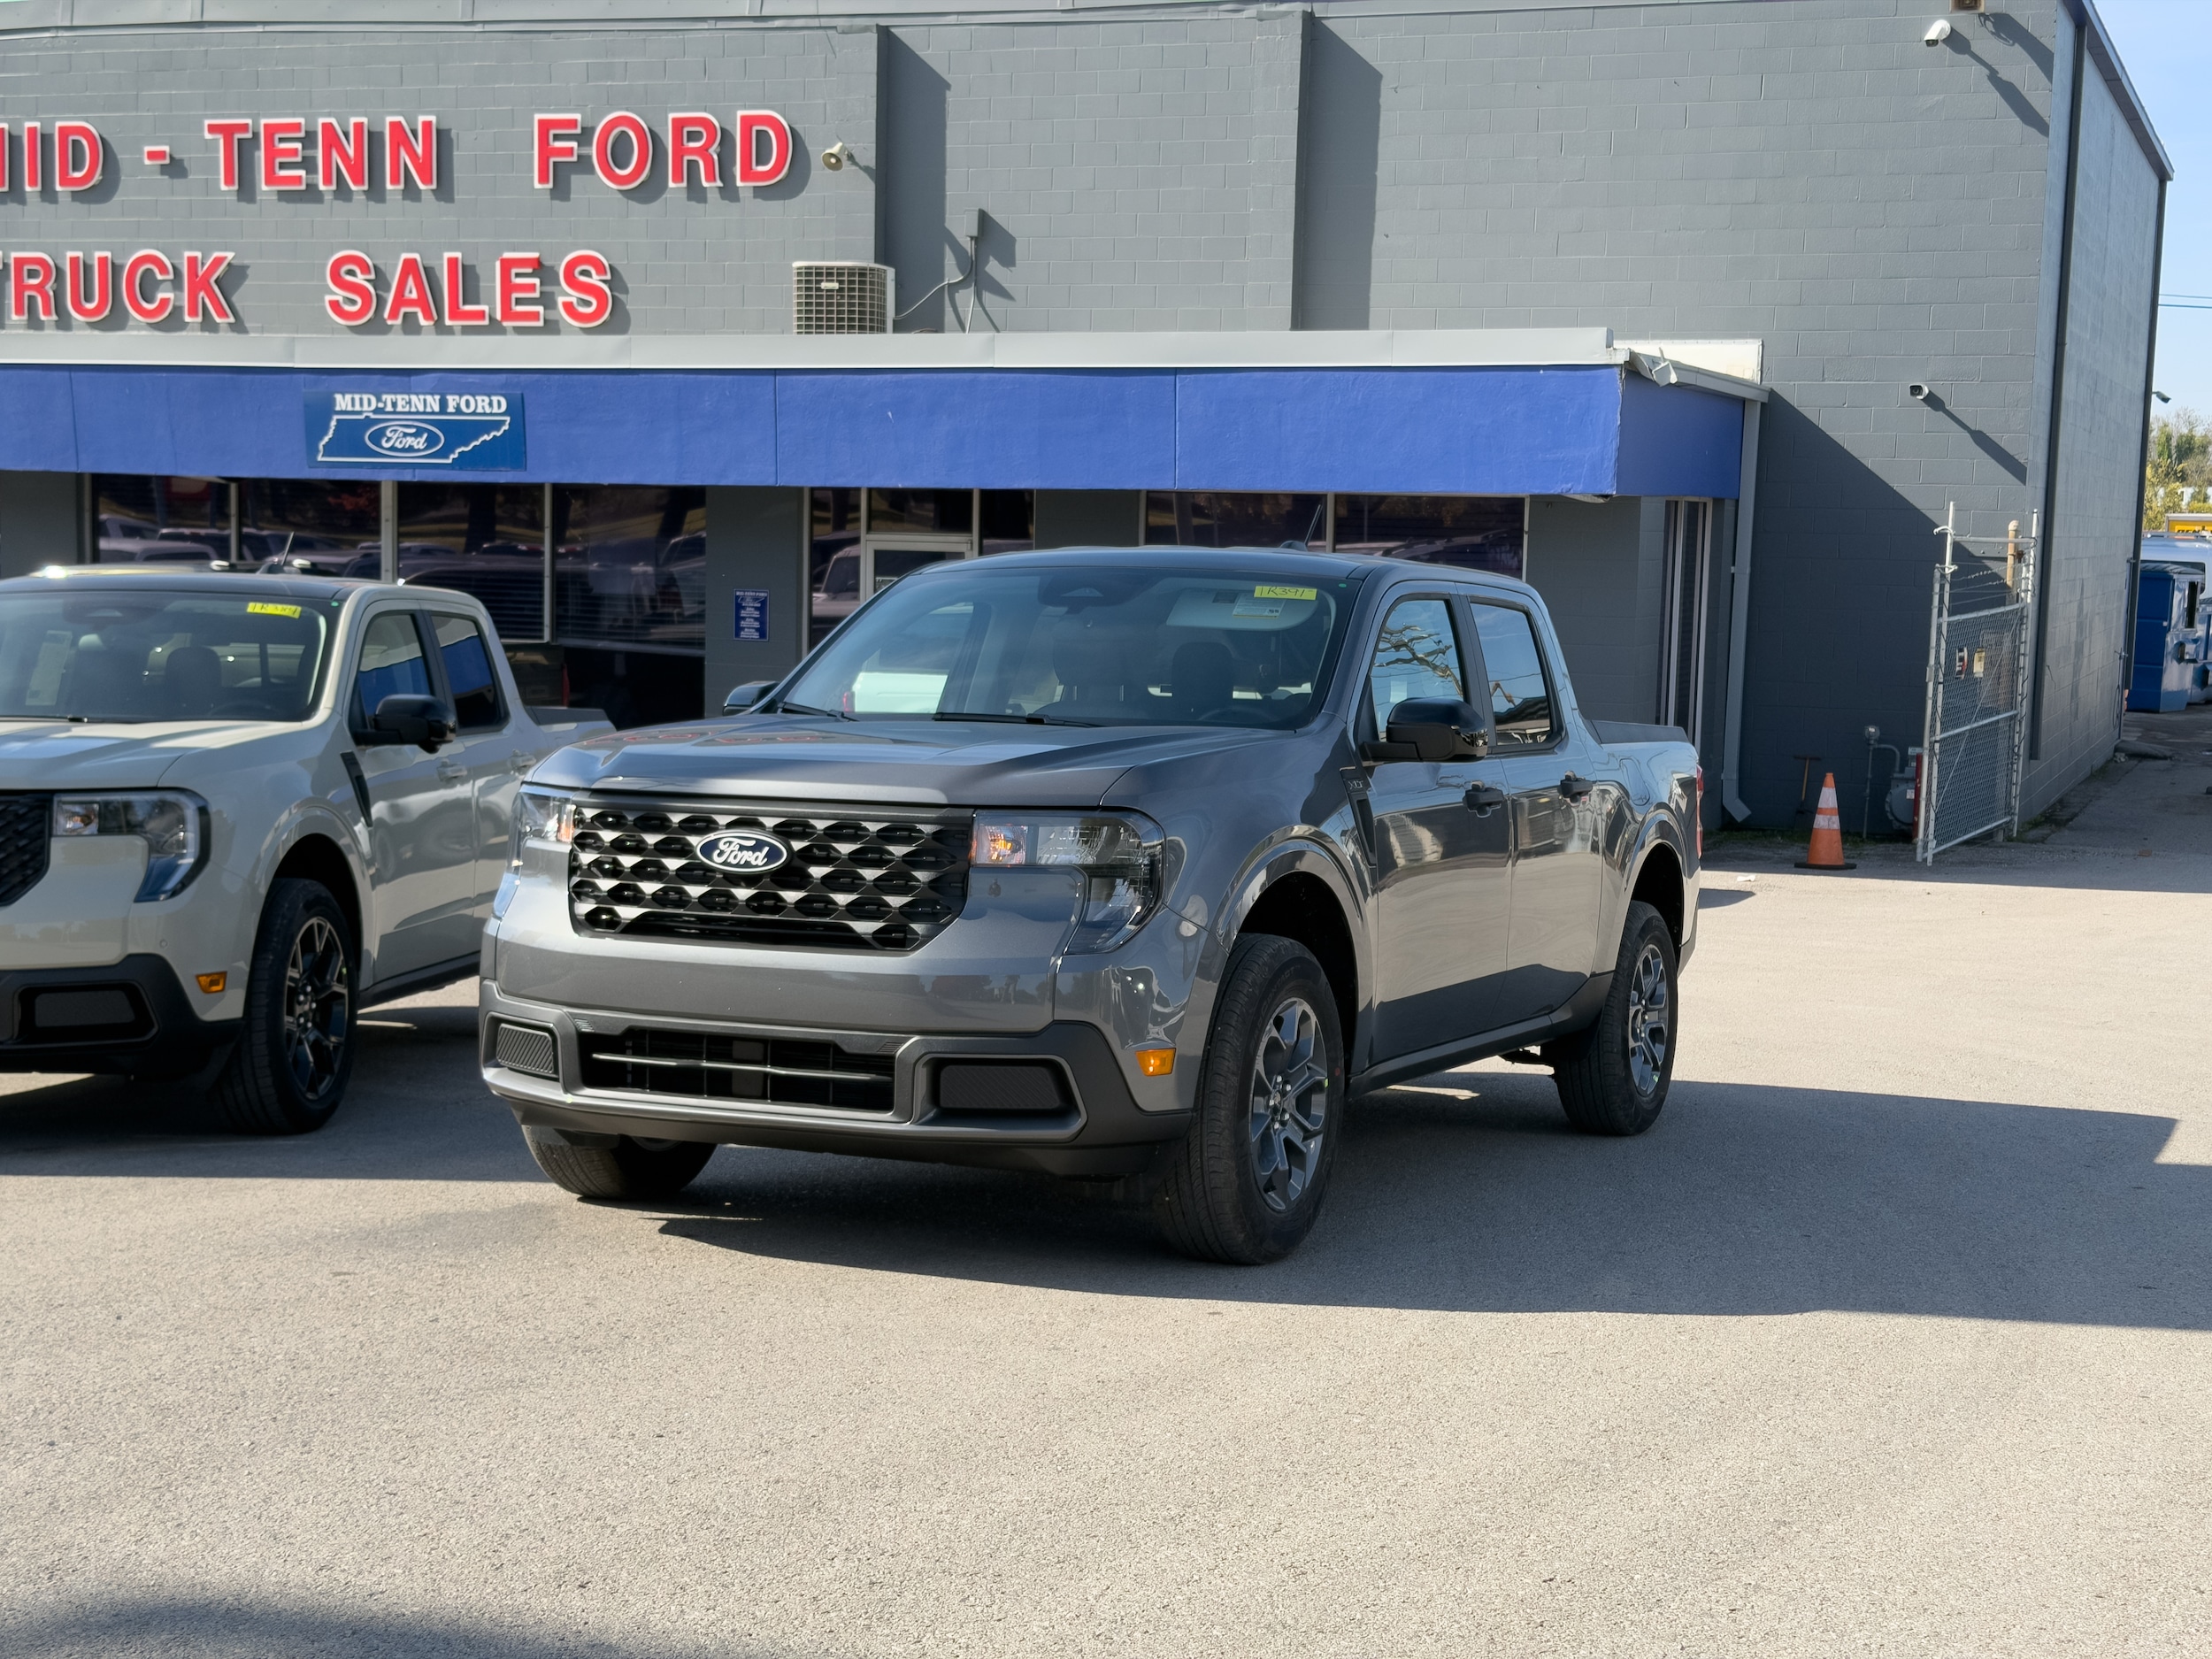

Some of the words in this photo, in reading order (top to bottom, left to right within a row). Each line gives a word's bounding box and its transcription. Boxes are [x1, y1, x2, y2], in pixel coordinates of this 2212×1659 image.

[0, 120, 104, 192] ID
[204, 116, 437, 191] TENN
[533, 110, 793, 190] FORD
[0, 249, 235, 324] RUCK
[325, 250, 612, 327] SALES
[334, 393, 441, 412] MID-TENN
[446, 395, 508, 413] FORD
[380, 425, 427, 449] Ford
[1348, 780, 1364, 790] XLT
[712, 837, 770, 866] Ford
